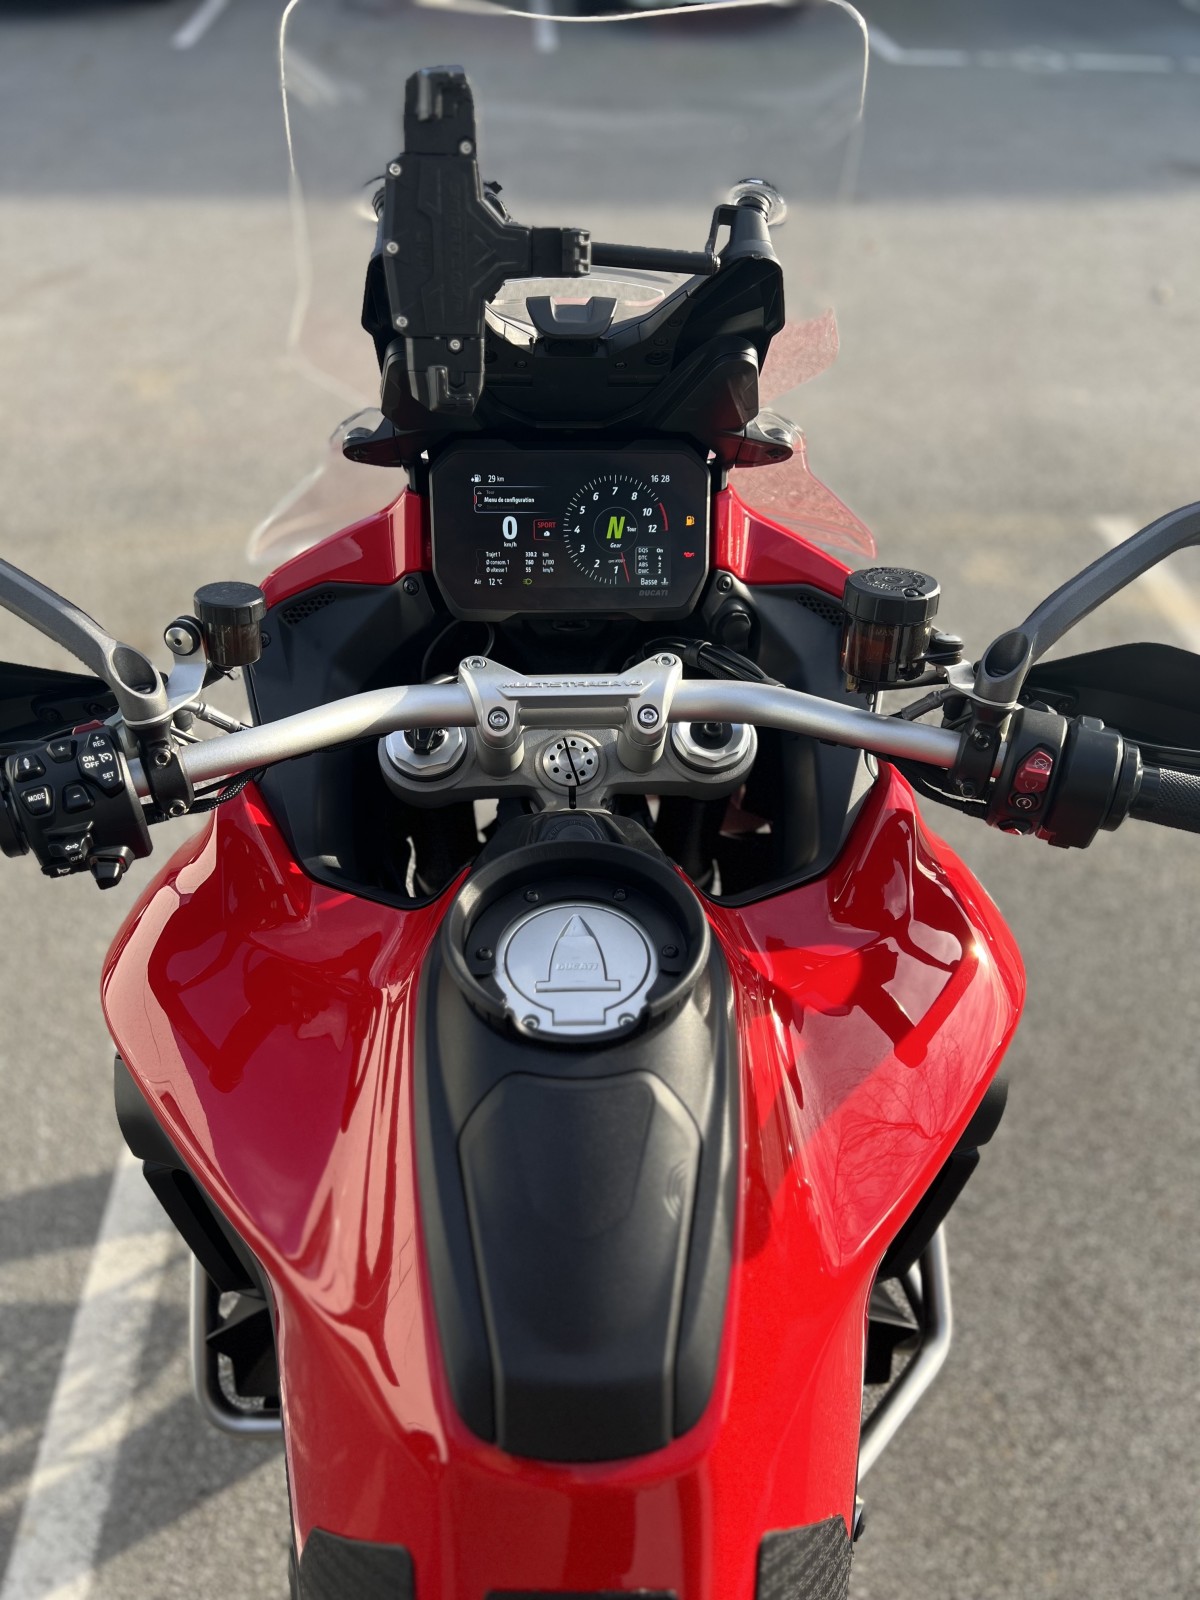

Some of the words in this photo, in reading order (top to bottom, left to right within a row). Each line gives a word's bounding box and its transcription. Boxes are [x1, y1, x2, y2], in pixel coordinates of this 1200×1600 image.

[612, 486, 618, 496] 7
[504, 496, 534, 504] configuration
[592, 492, 599, 500] 6
[631, 492, 638, 500] 8
[579, 506, 586, 514] 5
[642, 508, 652, 516] 10
[502, 516, 518, 540] 0
[574, 526, 580, 534] 4
[606, 516, 625, 539] N
[648, 524, 658, 532] 12
[580, 544, 586, 552] 3
[594, 560, 600, 568] 2
[614, 566, 618, 574] 1
[640, 578, 658, 586] Basse
[502, 680, 622, 688] MULTISTRADA
[92, 740, 106, 748] RES
[84, 761, 100, 769] OFF
[28, 792, 46, 802] MODE
[70, 854, 83, 862] OFF
[556, 962, 599, 970] DUCATI
